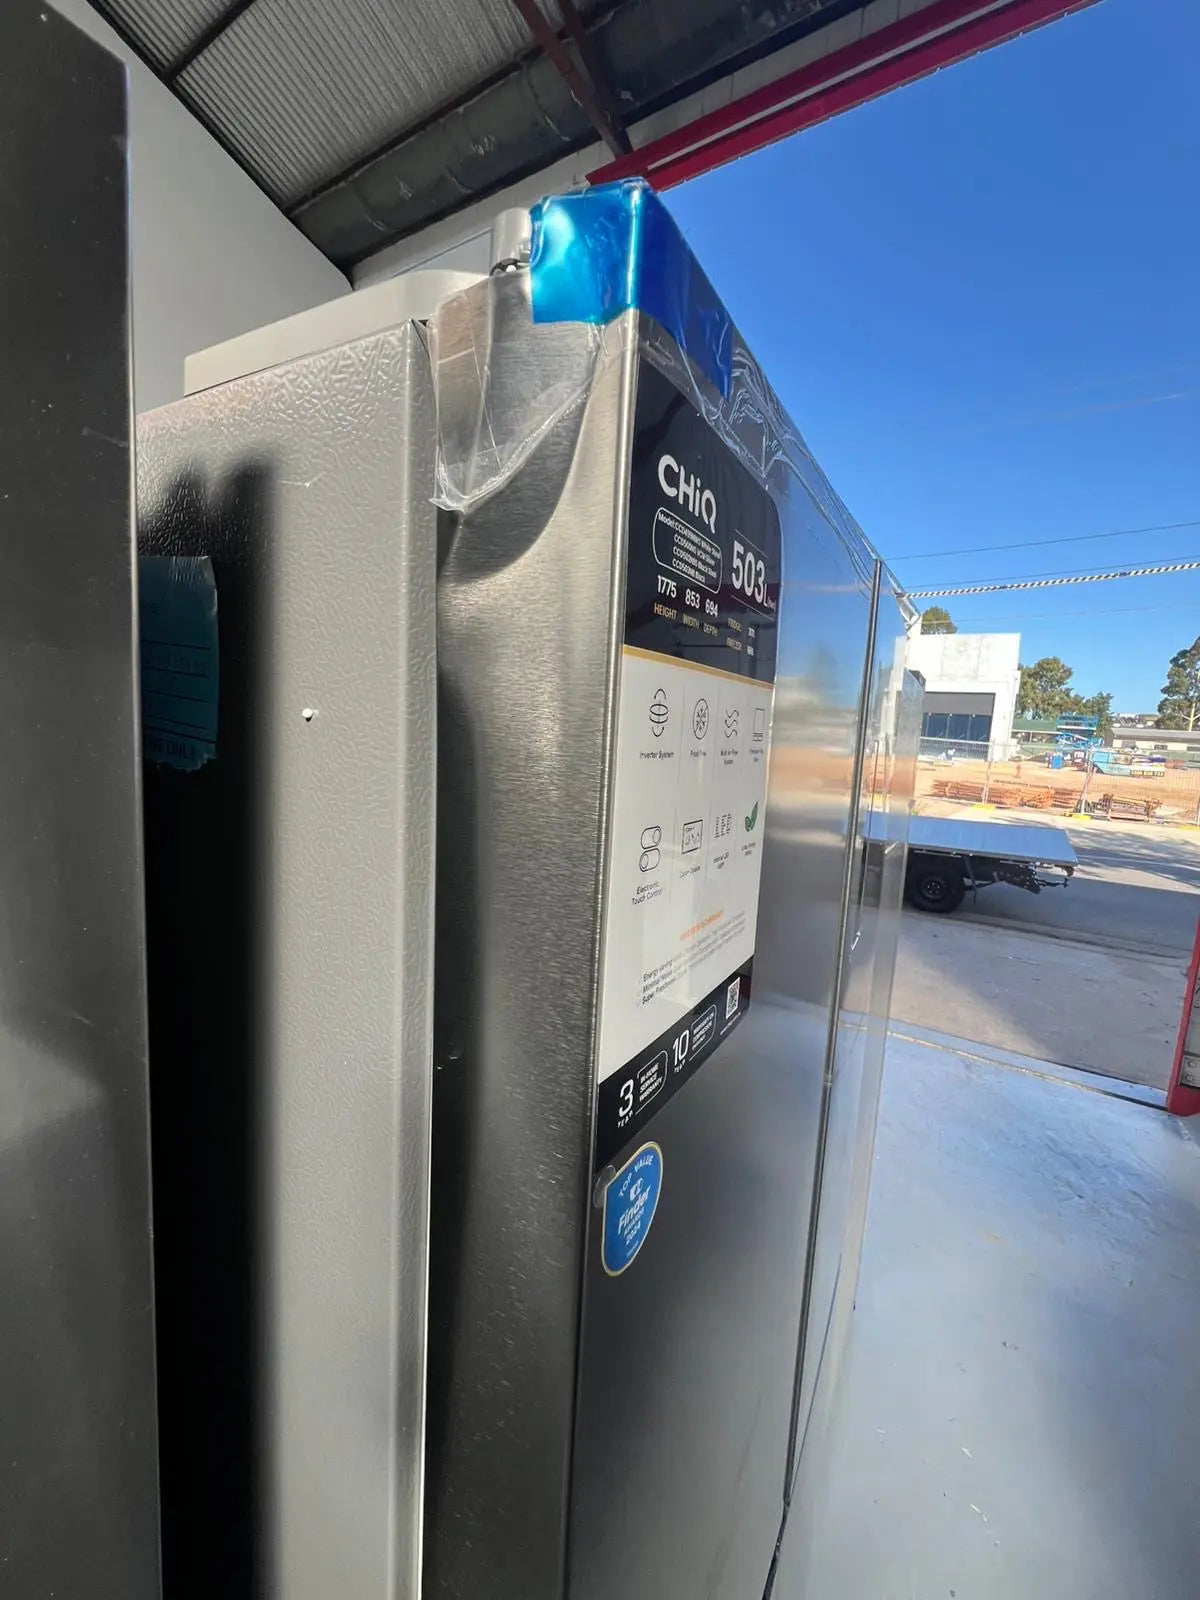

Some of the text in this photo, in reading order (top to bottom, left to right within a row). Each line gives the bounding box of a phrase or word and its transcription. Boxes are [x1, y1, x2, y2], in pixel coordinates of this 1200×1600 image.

[658, 454, 717, 534] CHiQ
[657, 574, 719, 618] 1775 853 694
[653, 601, 719, 637] HEIGHT WIDTH DEPTH
[658, 750, 675, 760] System
[631, 888, 662, 905] Touch Control
[636, 881, 660, 894] Electronic
[672, 1029, 689, 1066] 10
[619, 1079, 634, 1117] 3
[639, 1076, 663, 1102] WARRANTY
[640, 1072, 658, 1093] SERVICE
[619, 1155, 654, 1197] TOP VALUE
[617, 1184, 651, 1235] Finder
